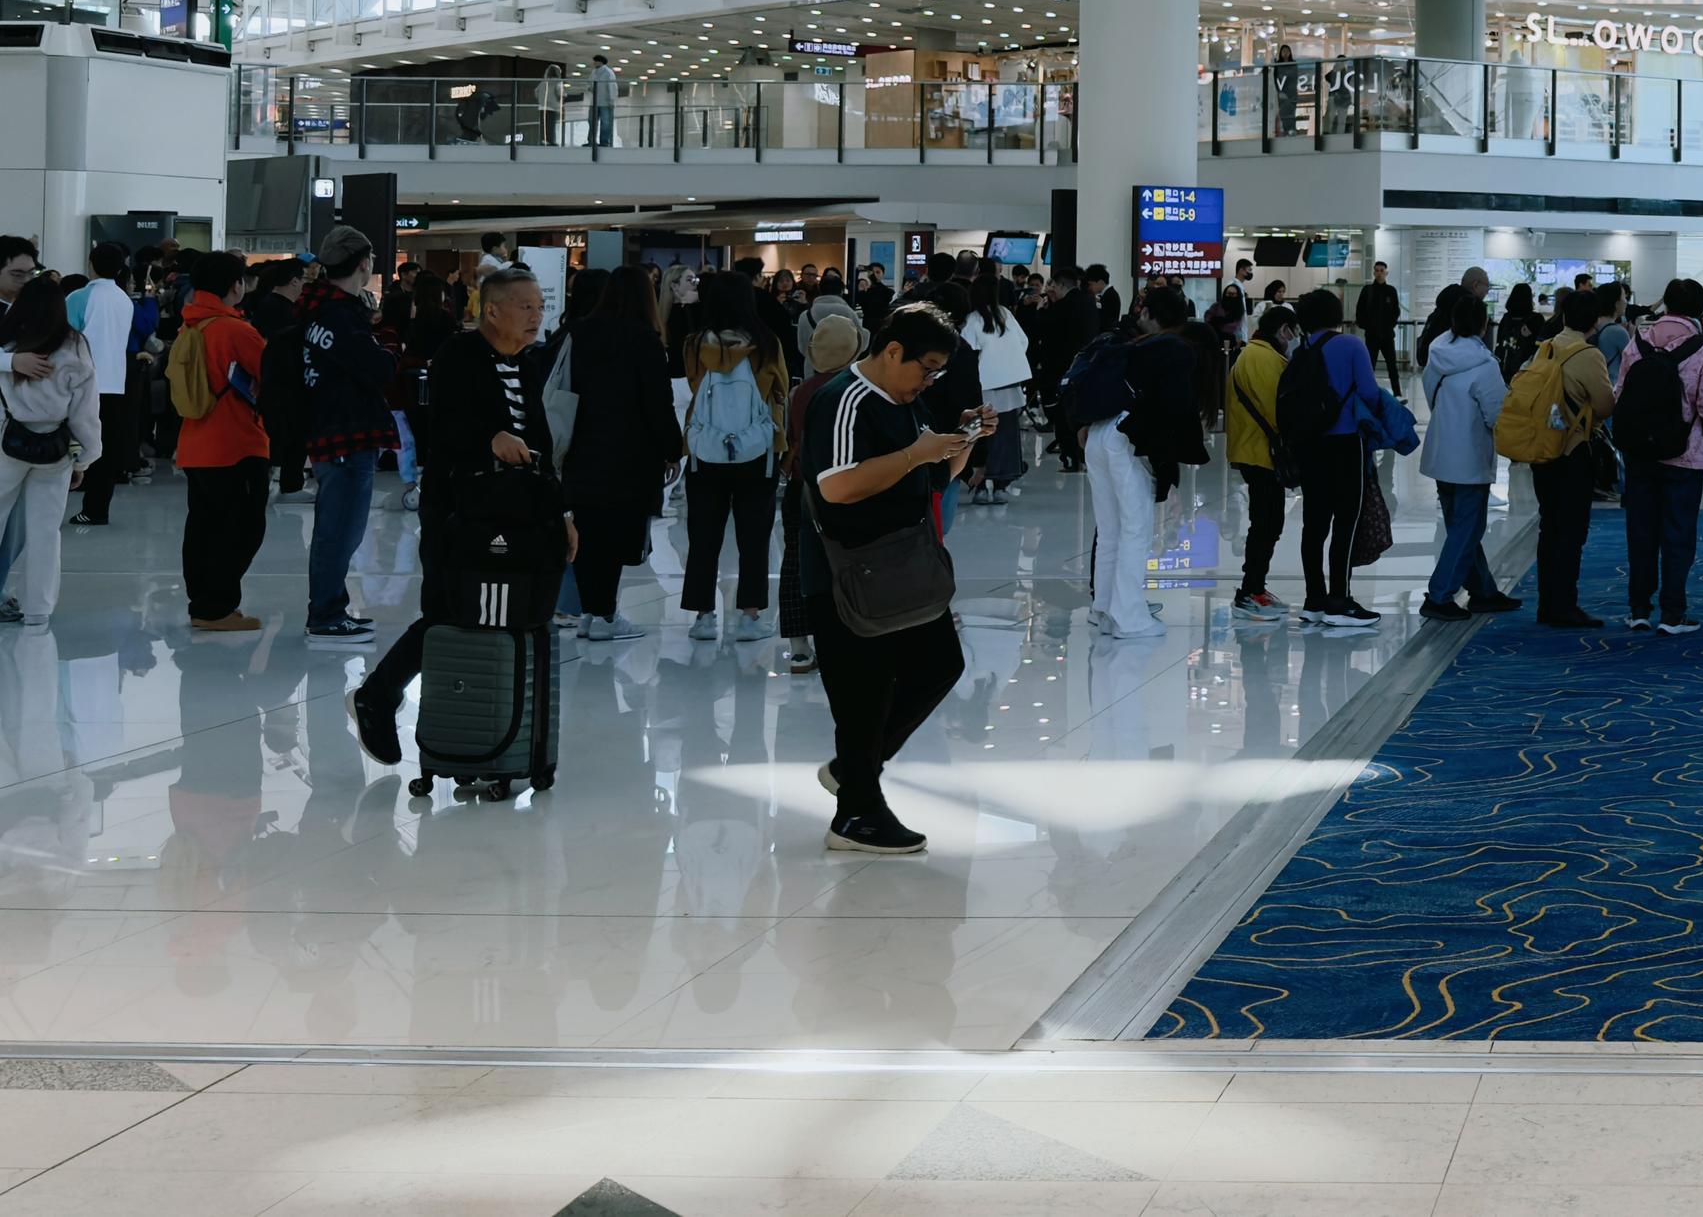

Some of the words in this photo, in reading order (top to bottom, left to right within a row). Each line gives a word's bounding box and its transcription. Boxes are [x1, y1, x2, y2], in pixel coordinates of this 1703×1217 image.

[1180, 190, 1196, 203] 1-4
[1179, 208, 1196, 221] 5-9
[396, 218, 408, 228] xit
